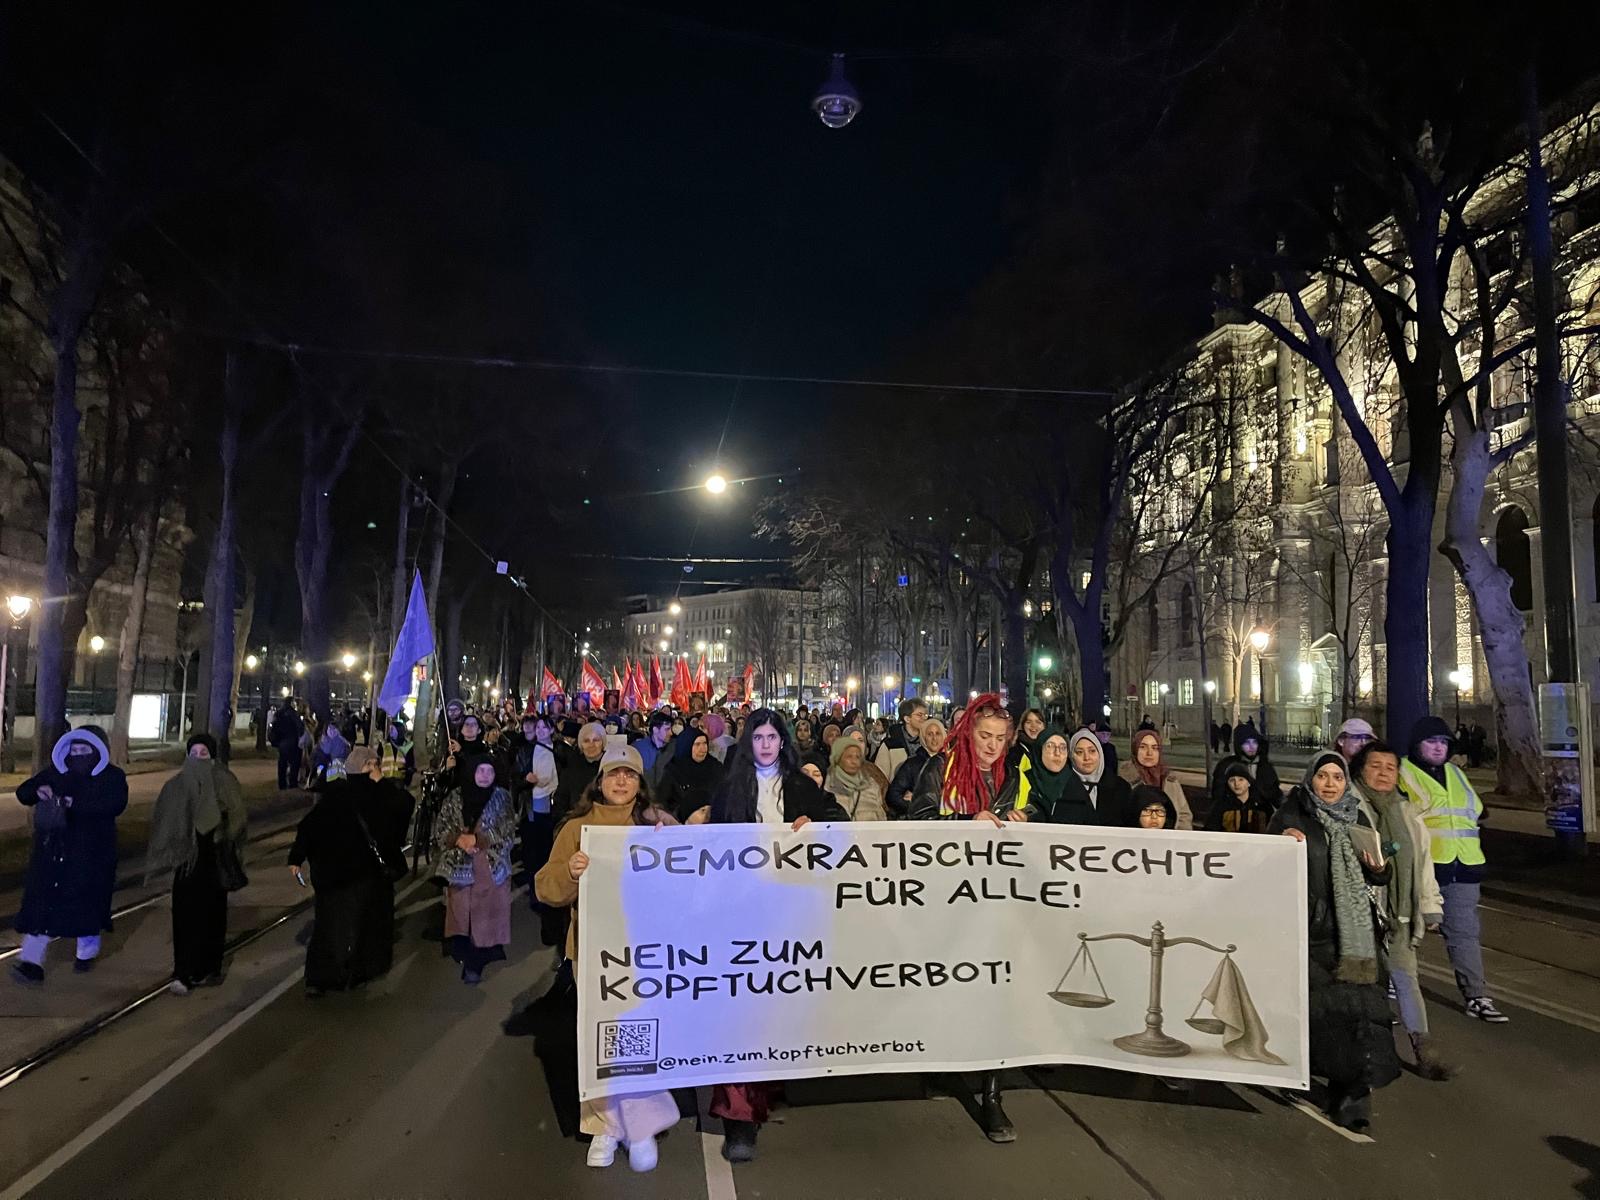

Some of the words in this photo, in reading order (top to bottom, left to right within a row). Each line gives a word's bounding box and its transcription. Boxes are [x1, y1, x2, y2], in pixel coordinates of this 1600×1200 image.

[629, 839, 1026, 877] DEMOKRATISCHE
[1049, 844, 1234, 880] RECHTE
[835, 877, 926, 910] FÜR
[947, 879, 1081, 909] ALLE!
[600, 943, 708, 971] NEIN
[729, 939, 823, 966] ZUM
[599, 960, 1012, 1002] KOPFTUCHVERBOT!
[657, 1039, 926, 1071] @nein.zum.kopftuchverbot
